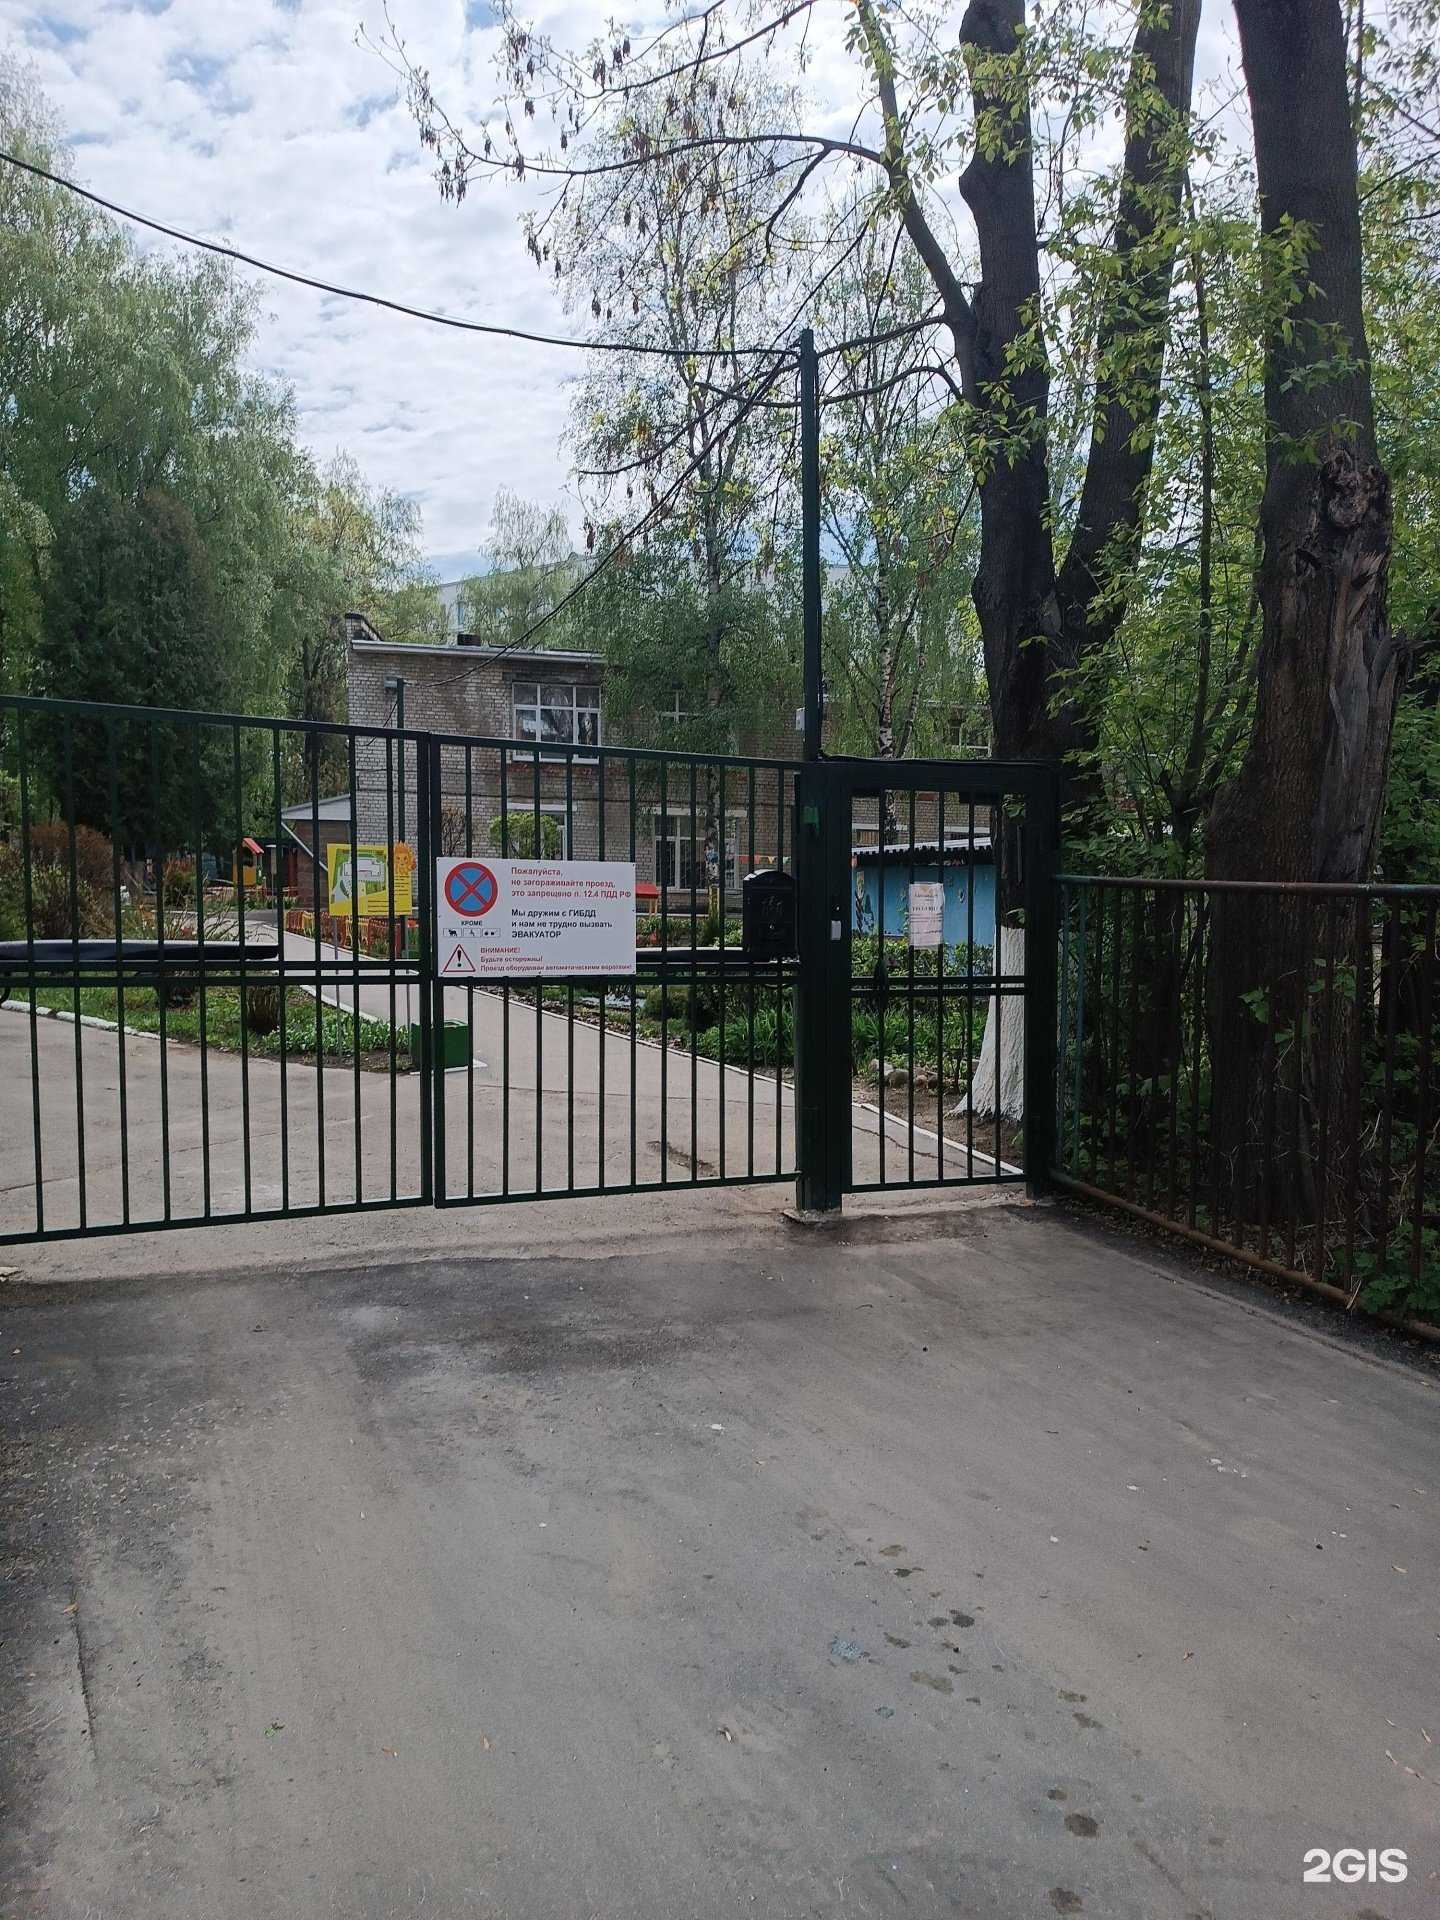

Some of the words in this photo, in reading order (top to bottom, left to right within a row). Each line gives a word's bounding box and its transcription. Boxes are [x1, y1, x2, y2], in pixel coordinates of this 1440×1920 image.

[511, 867, 563, 876] Пожалуйста,
[523, 879, 583, 887] загораживайте
[585, 880, 616, 888] проезд,
[527, 890, 572, 898] запрещено
[600, 890, 617, 899] ПДД
[620, 890, 632, 898] РФ
[511, 909, 526, 917] Мы
[527, 910, 560, 918] дружим
[568, 909, 596, 918] ГИБДД
[549, 921, 578, 929] трудно
[480, 956, 503, 964] Будьте
